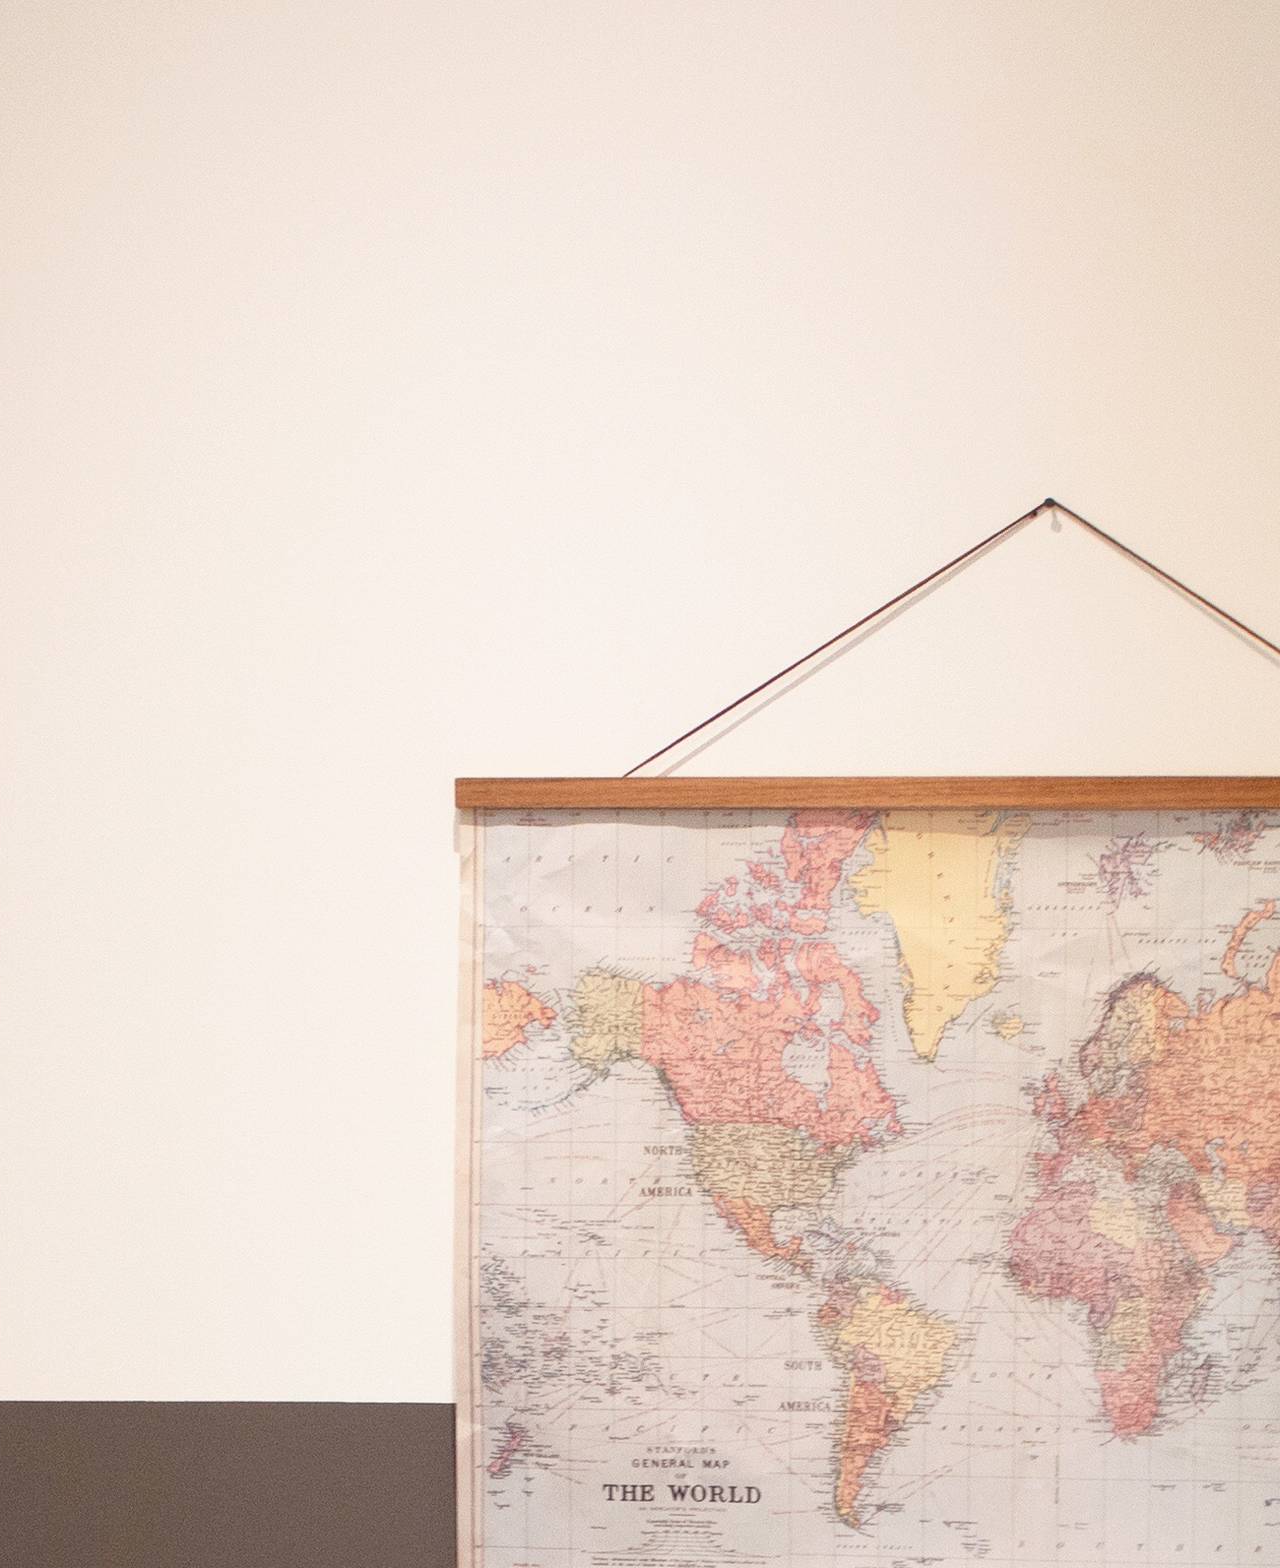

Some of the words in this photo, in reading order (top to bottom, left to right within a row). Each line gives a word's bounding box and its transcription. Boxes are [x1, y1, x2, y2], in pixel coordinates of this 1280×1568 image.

[643, 1145, 683, 1156] NORTH
[639, 1186, 693, 1197] AMERICA
[783, 1360, 823, 1371] SOUTH
[778, 1401, 832, 1412] AMERICA
[631, 1458, 695, 1469] GENERAL
[702, 1460, 731, 1469] MAP
[602, 1484, 655, 1502] THE
[667, 1484, 762, 1504] WORLD
